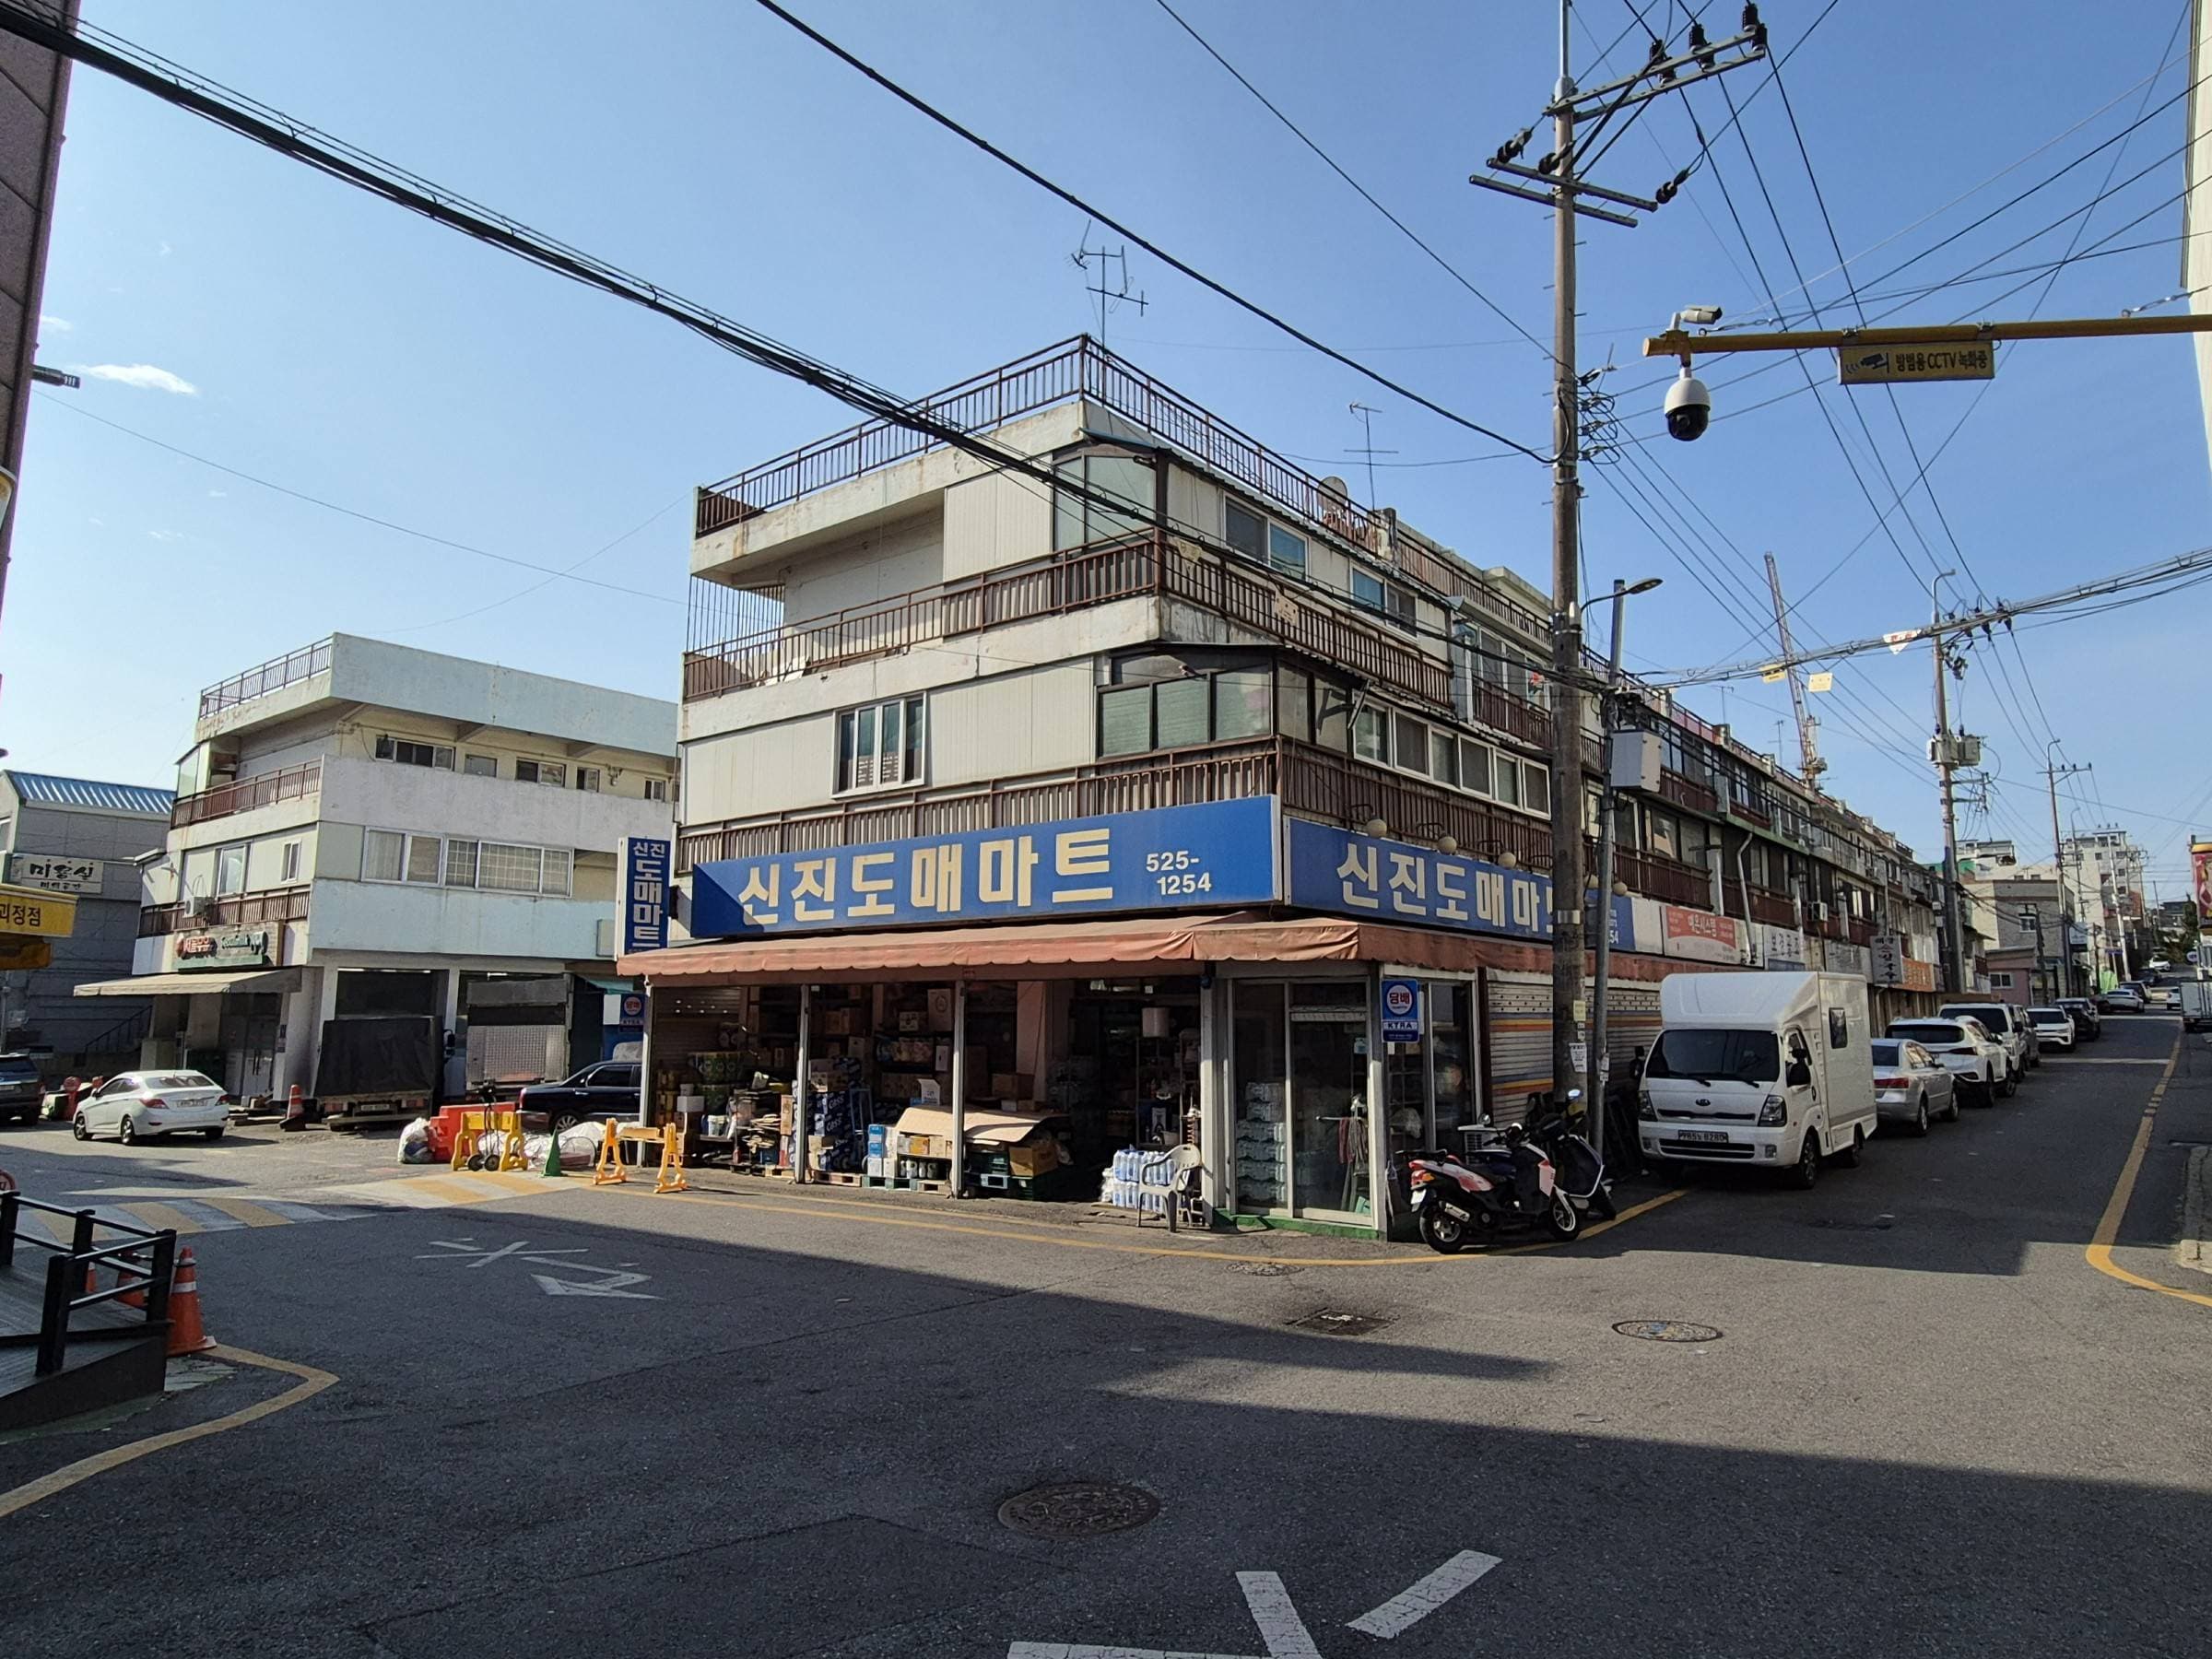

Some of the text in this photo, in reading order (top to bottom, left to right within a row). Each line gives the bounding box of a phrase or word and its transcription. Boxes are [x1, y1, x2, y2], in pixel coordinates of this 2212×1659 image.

[1895, 352, 1926, 372] 방범용
[1927, 352, 1958, 370] CCTV
[632, 841, 665, 859] 신진
[1146, 850, 1200, 873] 525-
[29, 858, 94, 881] 미용실
[738, 828, 1113, 925] 신진도매마트
[1157, 872, 1212, 896] 1254
[632, 860, 663, 947] 도매마트
[1389, 992, 1411, 1005] 담배
